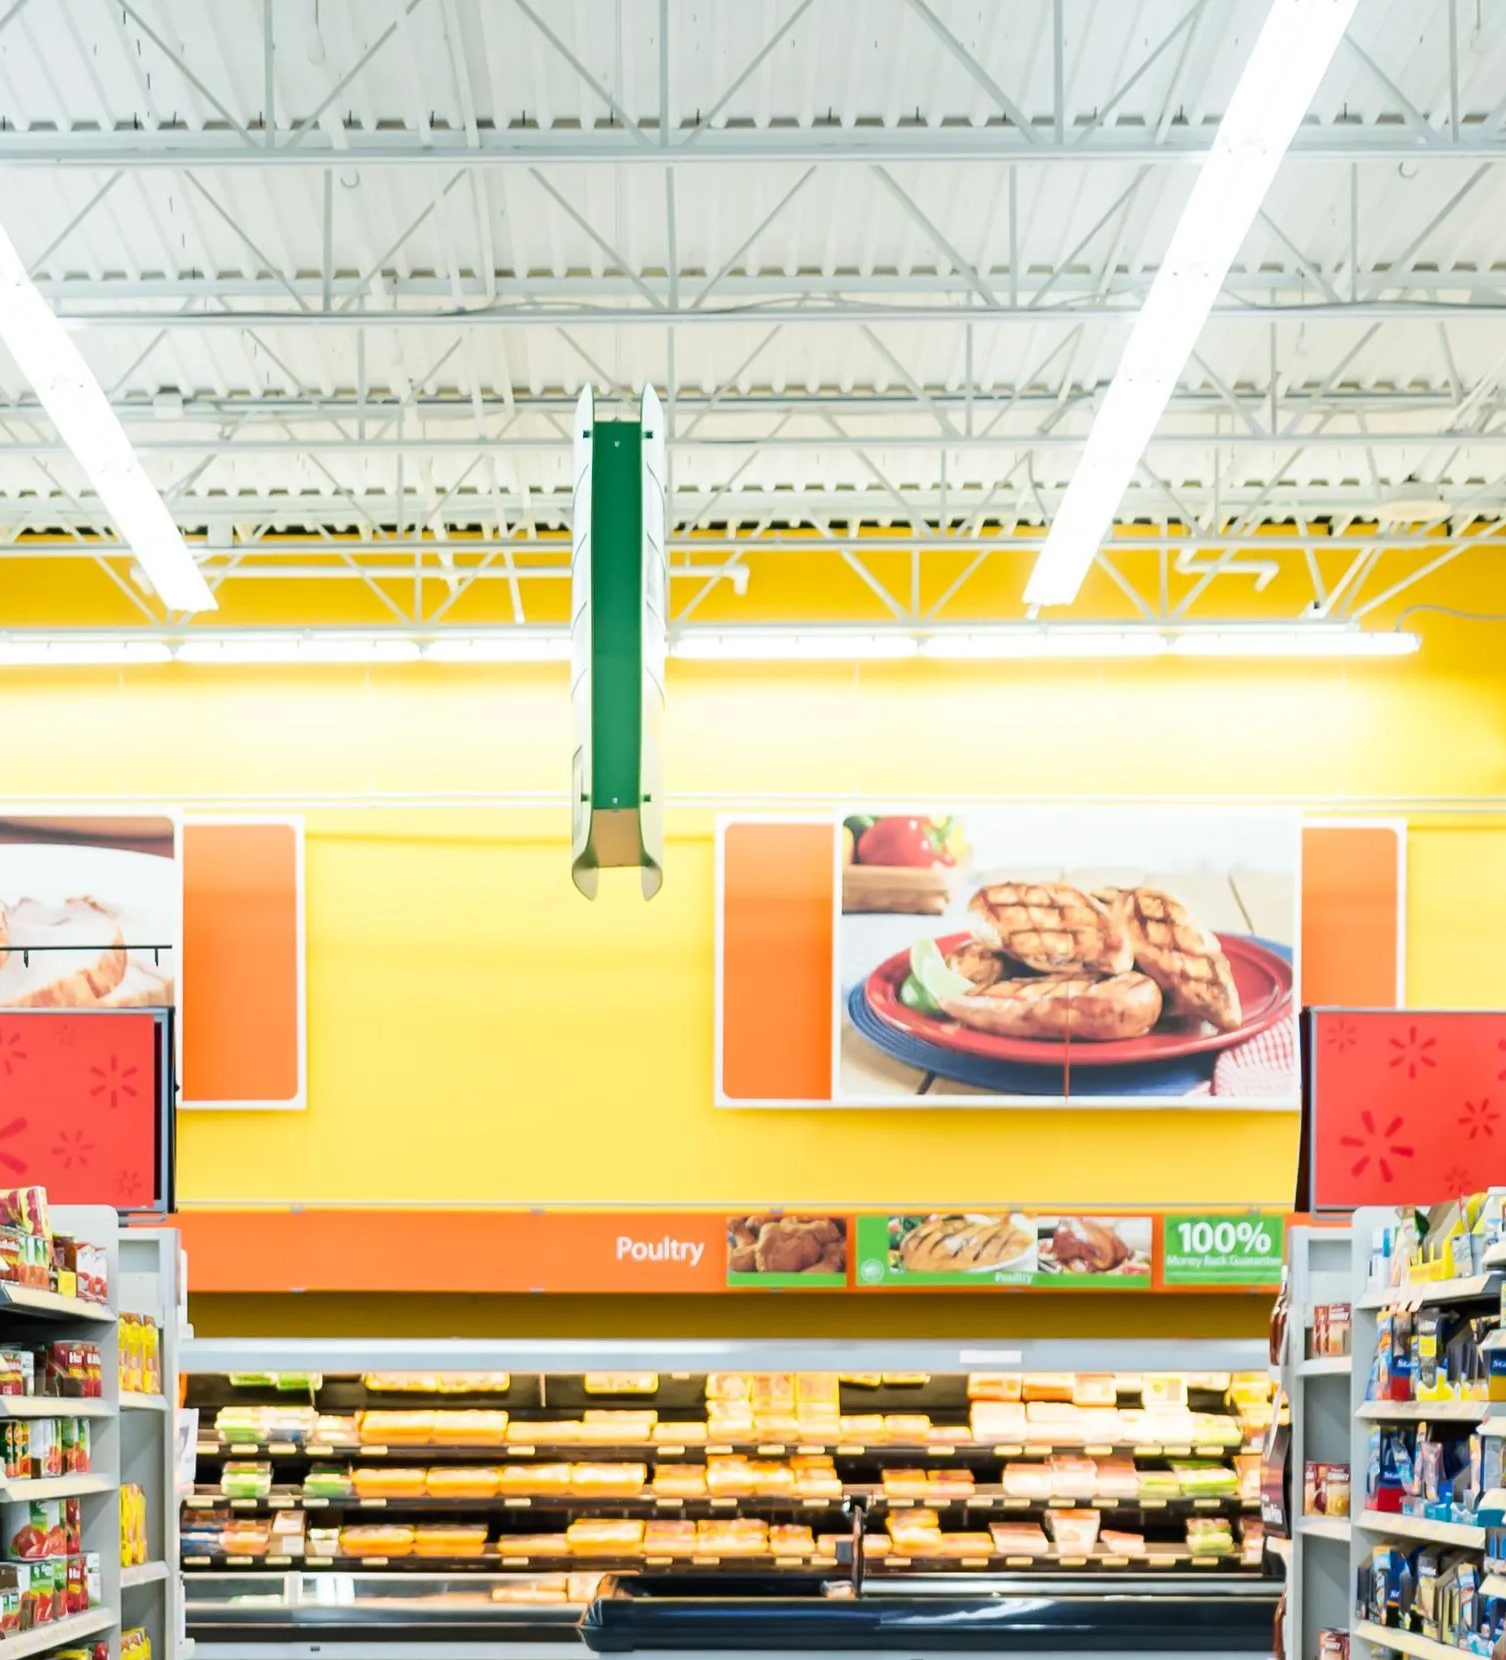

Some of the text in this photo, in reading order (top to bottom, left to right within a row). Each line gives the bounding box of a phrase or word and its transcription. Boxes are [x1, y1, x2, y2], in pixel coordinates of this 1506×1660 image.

[615, 1235, 706, 1267] Poultry
[1175, 1220, 1273, 1255] 100%
[995, 1271, 1034, 1285] Poultry
